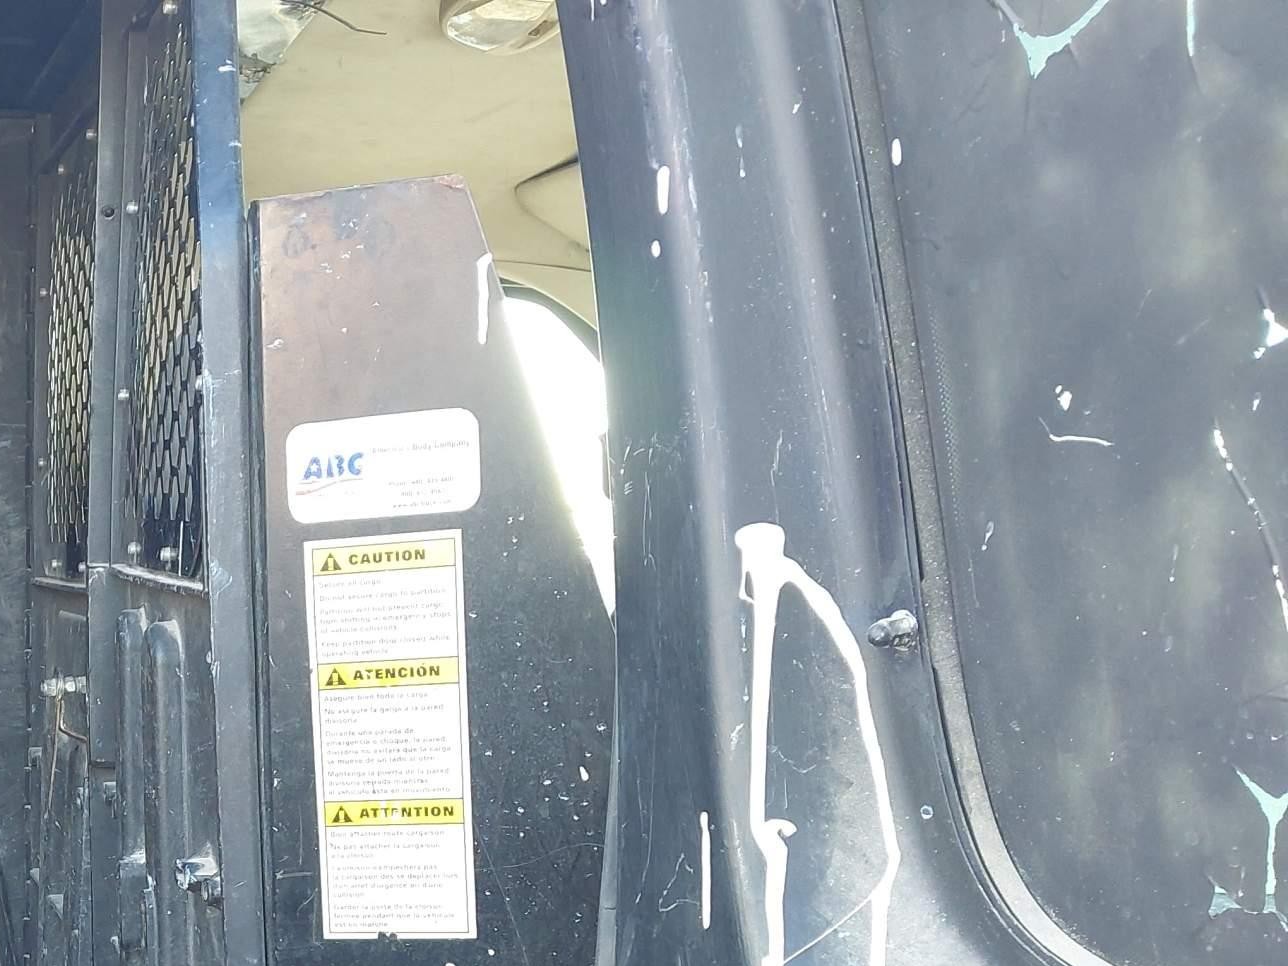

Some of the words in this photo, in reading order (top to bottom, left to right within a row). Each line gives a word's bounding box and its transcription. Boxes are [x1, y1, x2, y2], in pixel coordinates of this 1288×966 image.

[303, 452, 364, 480] ABC
[348, 548, 427, 566] CAUTION
[353, 662, 441, 681] ATENCIÓN
[359, 806, 455, 819] ATTENTION
